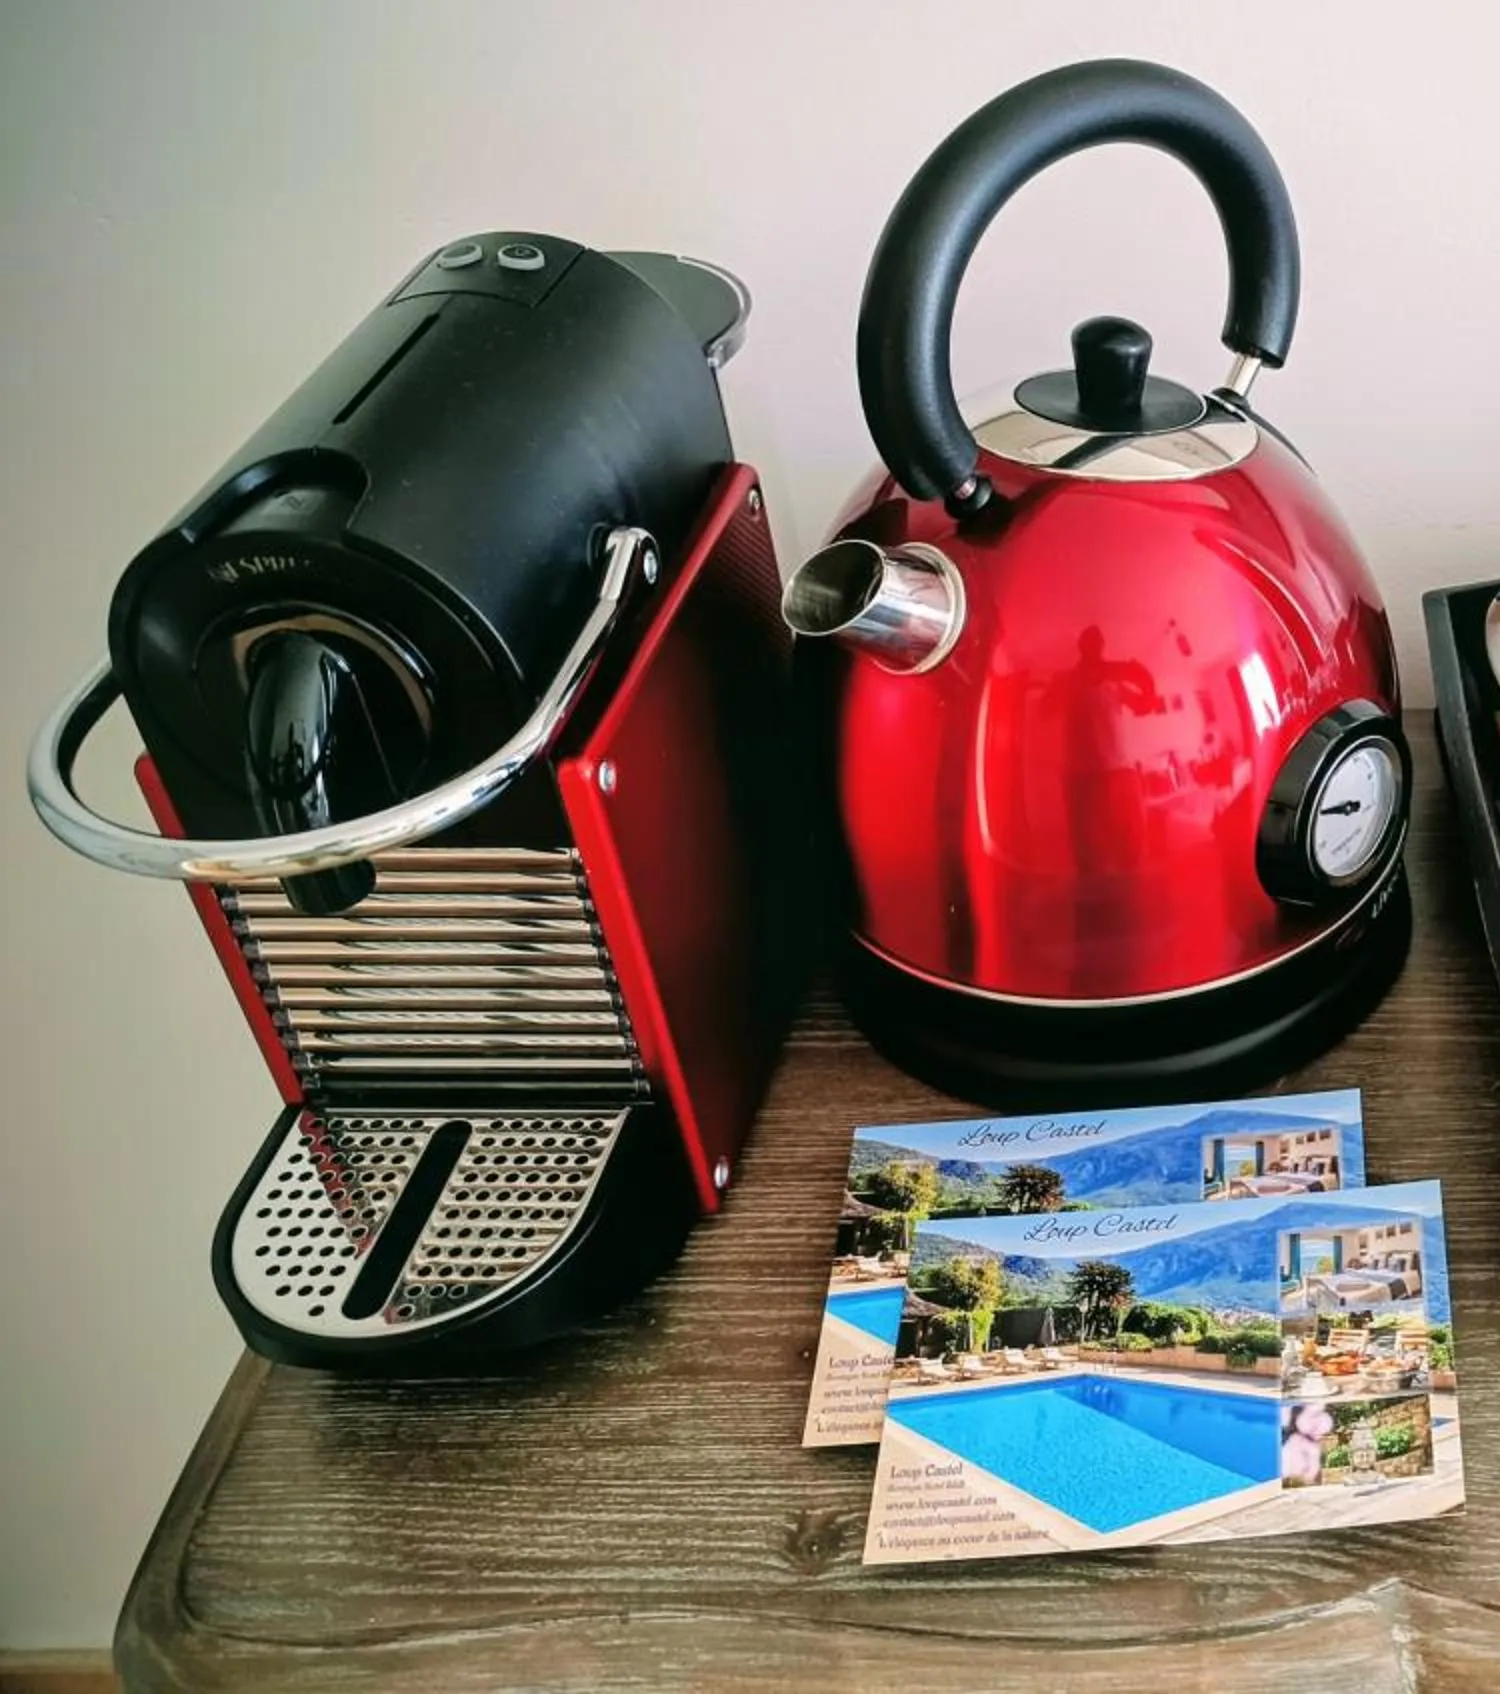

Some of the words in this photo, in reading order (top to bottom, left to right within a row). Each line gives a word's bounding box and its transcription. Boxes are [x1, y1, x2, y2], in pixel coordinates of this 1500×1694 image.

[957, 1123, 1021, 1148] Loup
[1025, 1119, 1108, 1142] Castel
[1023, 1217, 1088, 1242] Loup
[1093, 1213, 1180, 1237] Castel
[829, 1356, 859, 1372] Loup
[861, 1353, 894, 1367] Caste
[889, 1464, 922, 1481] Loup
[924, 1462, 964, 1477] Castel
